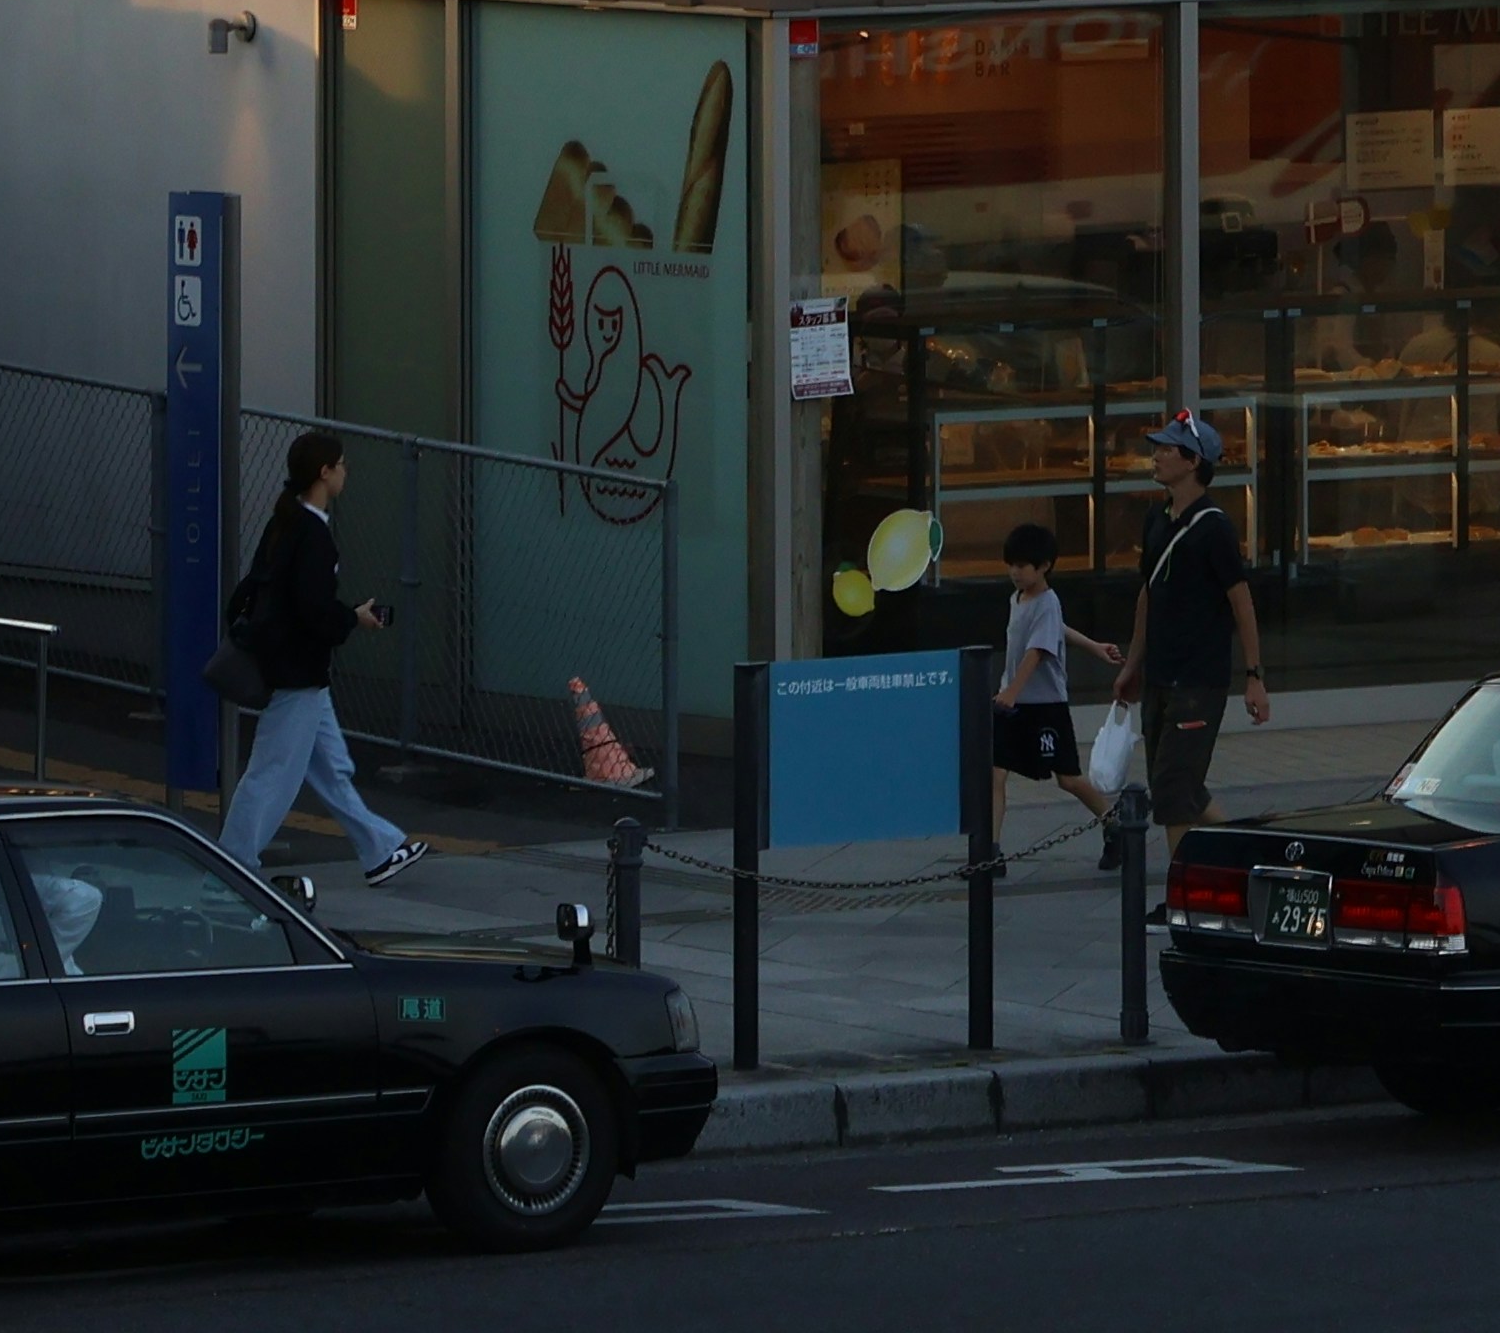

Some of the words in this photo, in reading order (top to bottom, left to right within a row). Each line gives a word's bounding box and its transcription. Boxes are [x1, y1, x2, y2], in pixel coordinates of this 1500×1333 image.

[186, 427, 201, 564] TOILET
[1280, 905, 1327, 936] 29-75
[401, 998, 442, 1021] 尾道
[173, 1068, 226, 1091] ビサン
[141, 1129, 264, 1160] ビサンタクシー
